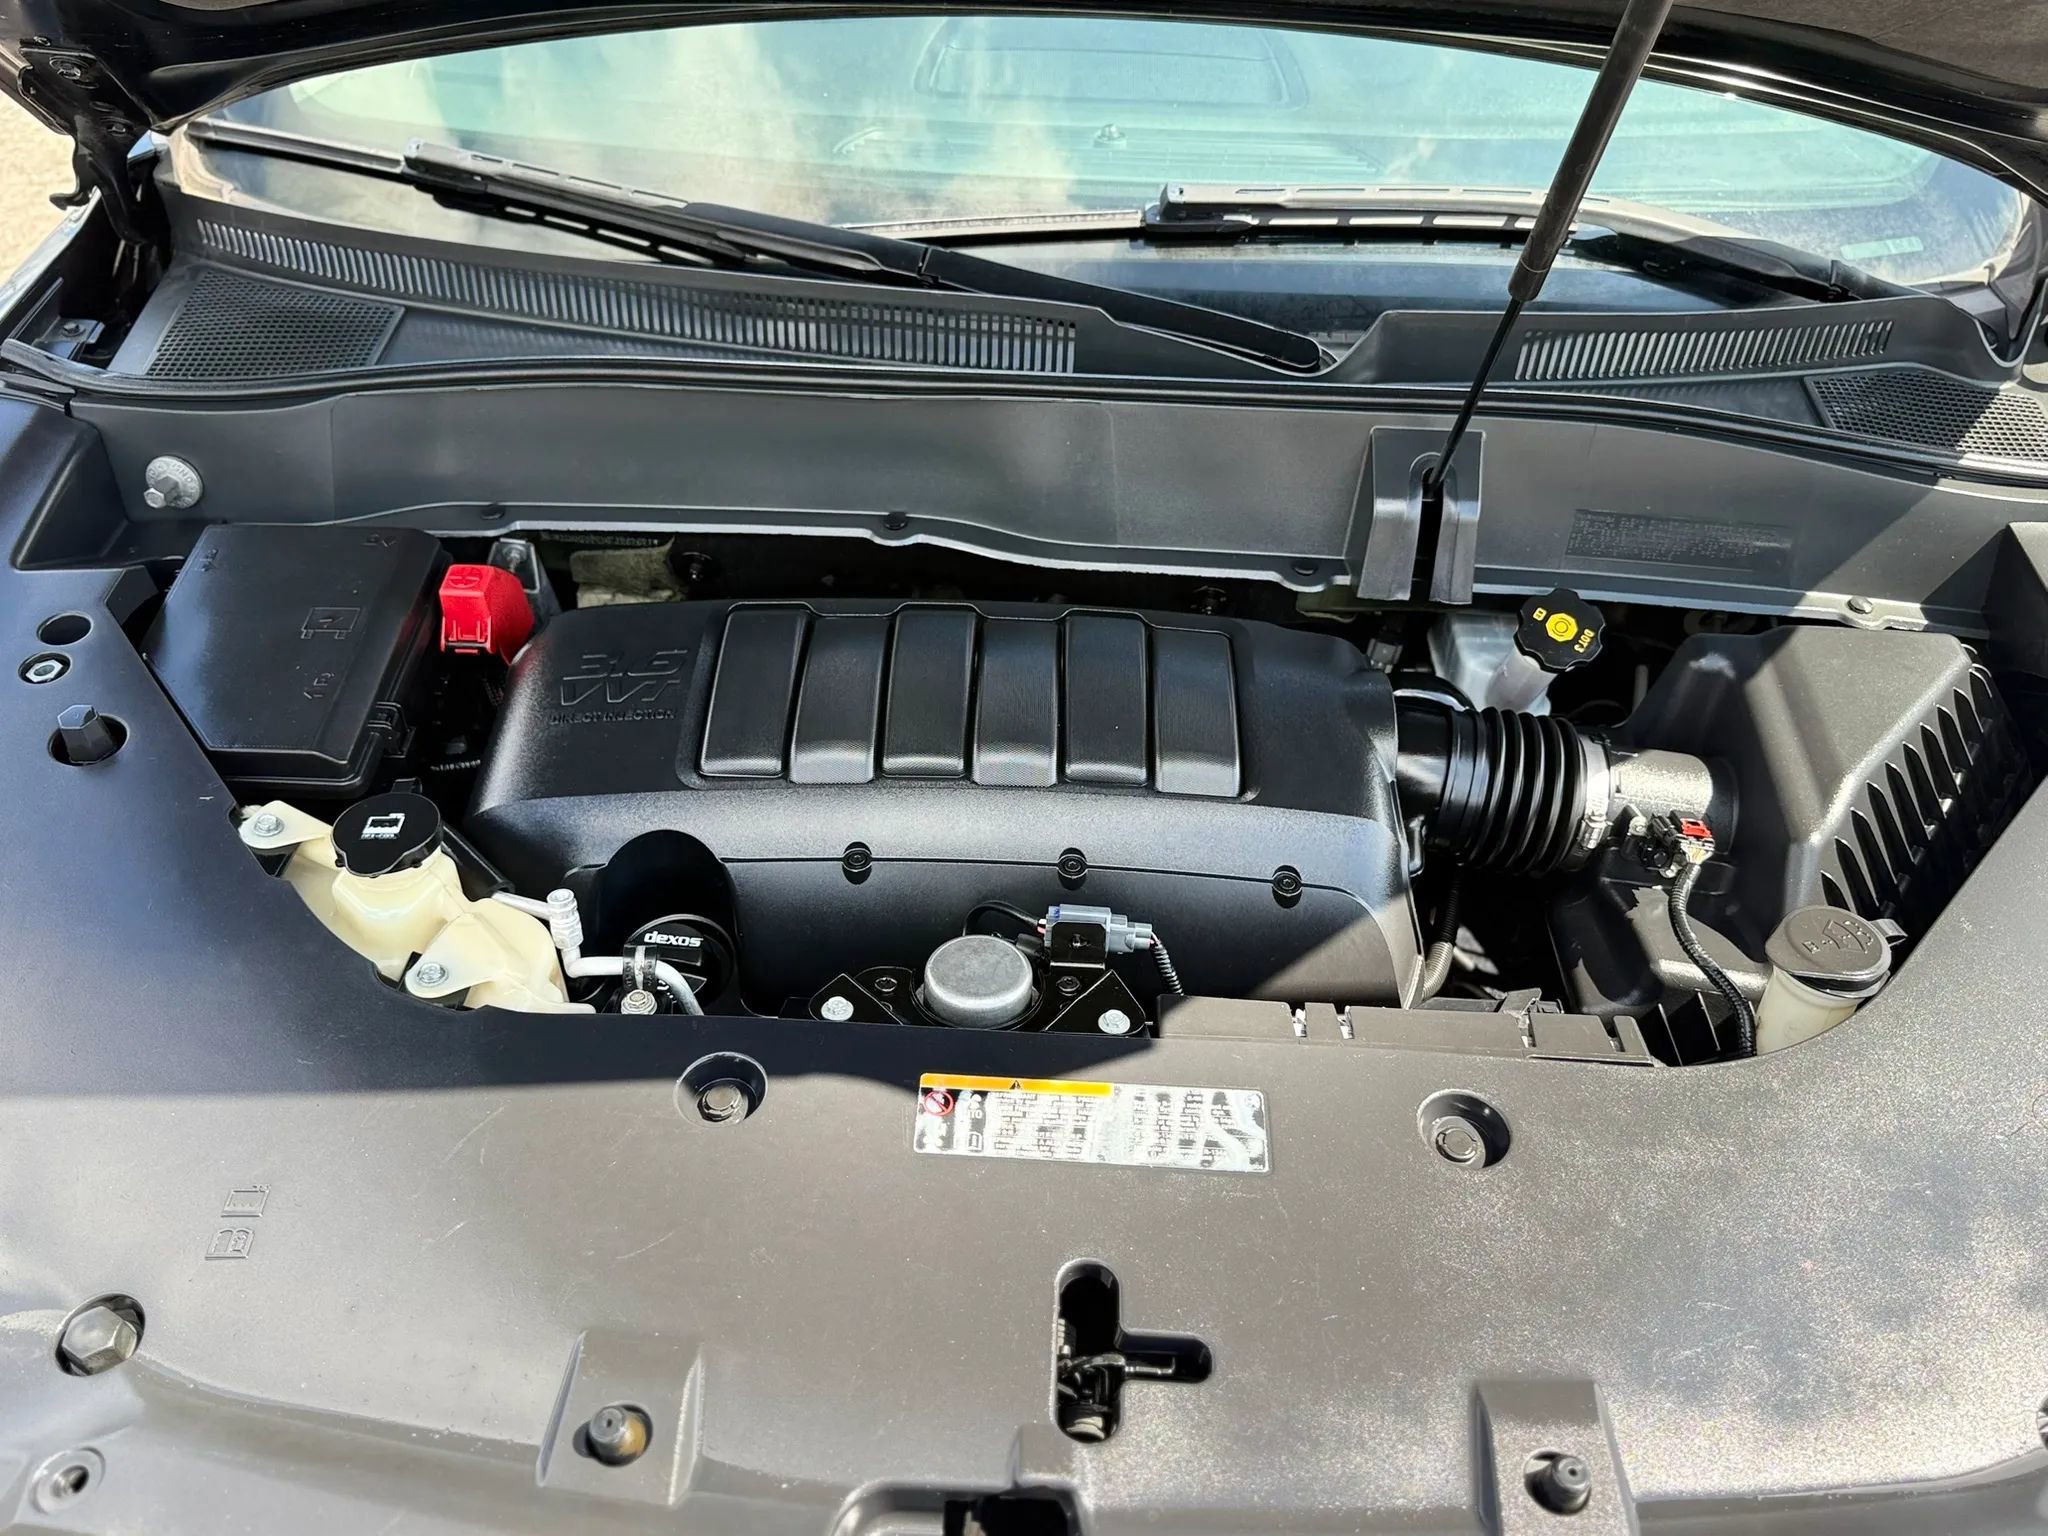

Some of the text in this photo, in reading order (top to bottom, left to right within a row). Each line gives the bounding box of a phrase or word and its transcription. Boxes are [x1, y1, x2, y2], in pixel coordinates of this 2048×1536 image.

[560, 679, 681, 706] VVT
[548, 708, 677, 725] DIRECT INJECTION
[643, 930, 704, 948] dexos
